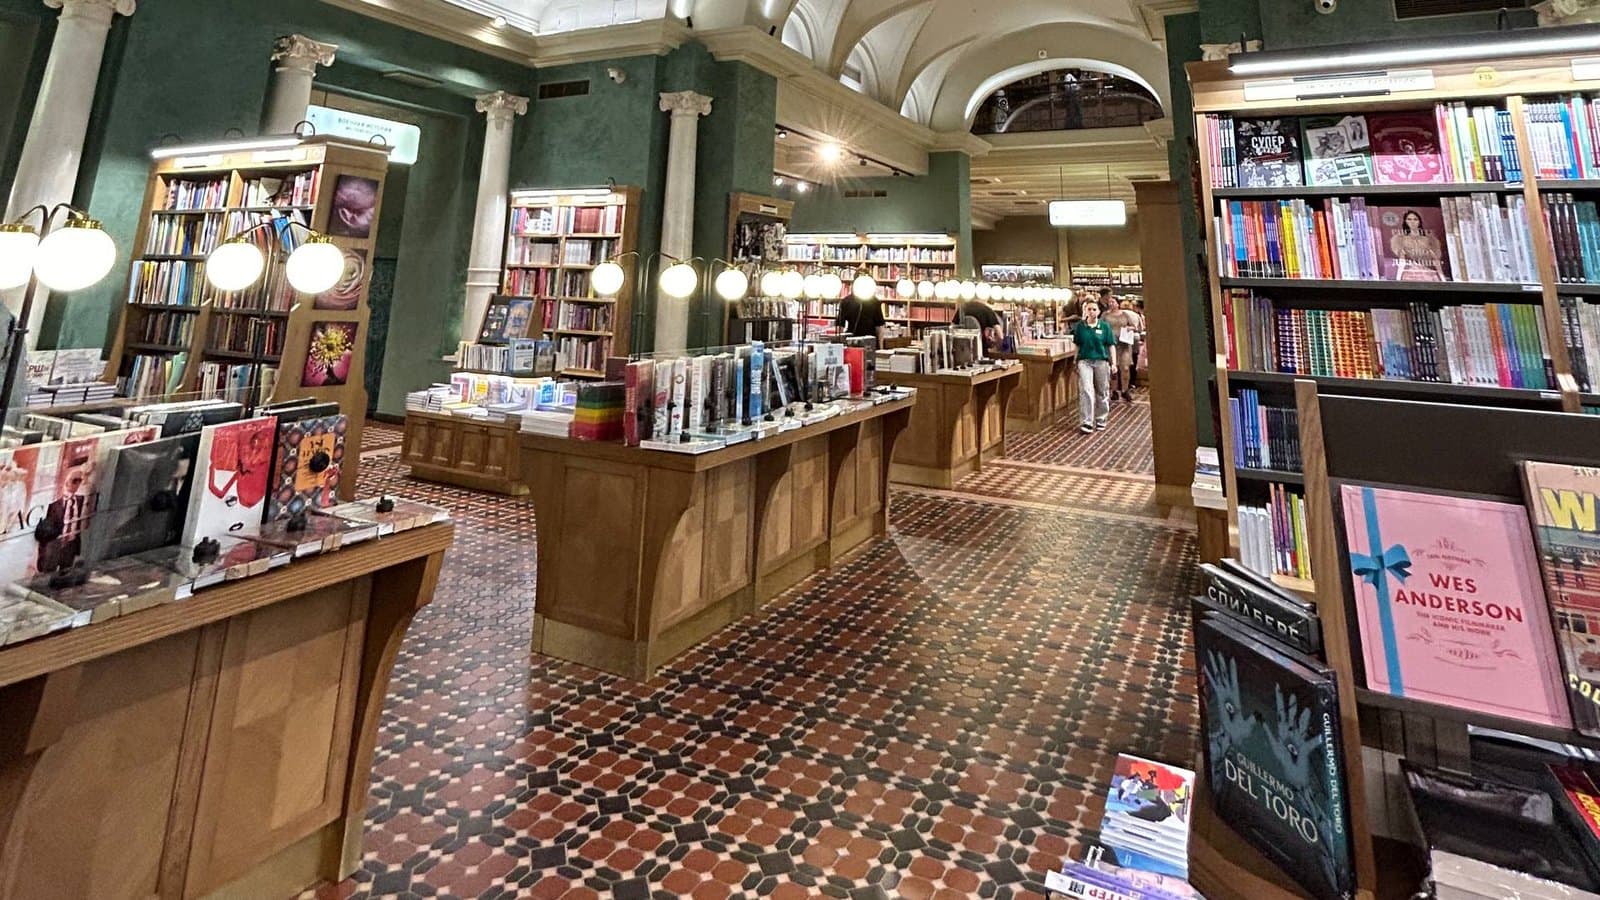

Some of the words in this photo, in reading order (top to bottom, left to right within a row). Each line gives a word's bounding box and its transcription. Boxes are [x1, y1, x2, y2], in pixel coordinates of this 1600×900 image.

[1251, 135, 1286, 149] СУПЕР
[1428, 572, 1478, 593] WES
[1395, 589, 1523, 623] ANDERSON
[1433, 621, 1450, 629] AND
[1451, 624, 1465, 632] HIS
[1467, 627, 1491, 636] WORK
[1460, 618, 1506, 631] FILMMAKER
[1322, 712, 1336, 777] GUILLERMO
[1237, 752, 1295, 801] GUILLERMO
[1331, 779, 1340, 800] DEL
[1224, 757, 1259, 800] DEL
[1260, 784, 1319, 845] TORO
[1333, 801, 1343, 834] TORO
